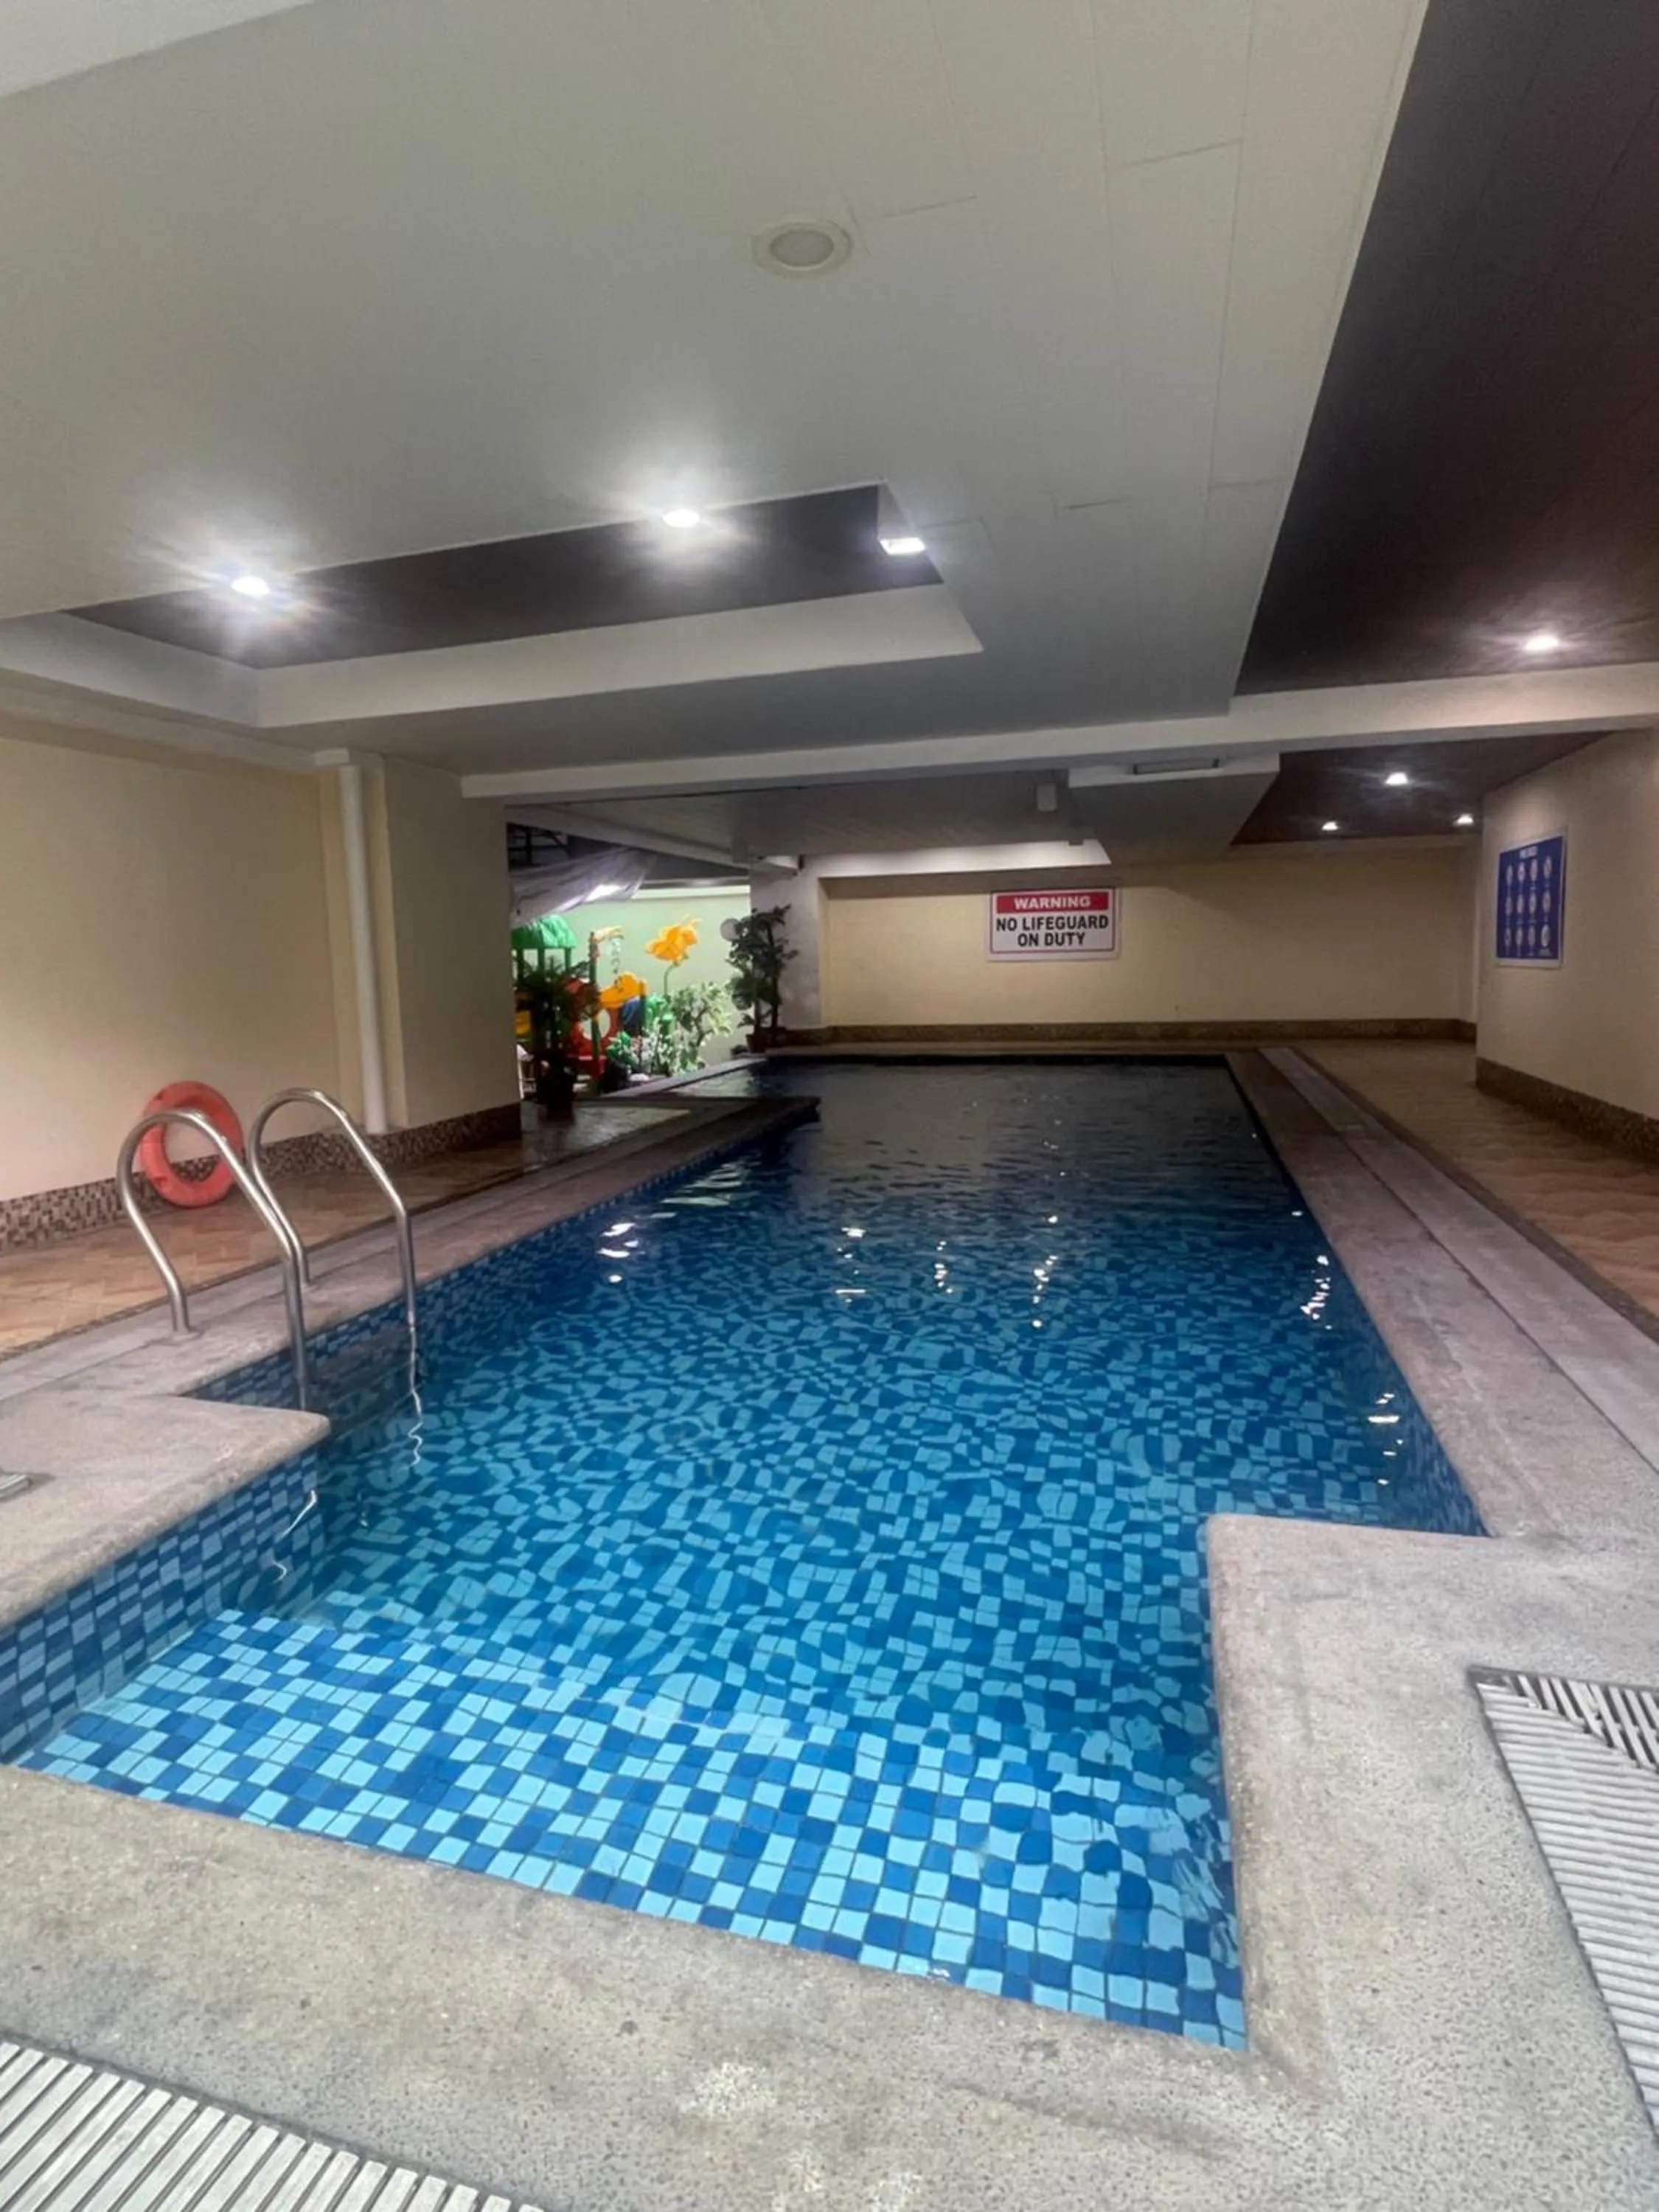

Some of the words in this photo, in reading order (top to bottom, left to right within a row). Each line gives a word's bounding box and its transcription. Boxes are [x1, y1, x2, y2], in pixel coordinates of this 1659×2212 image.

[1014, 896, 1091, 909] WARNING
[996, 917, 1017, 931] NO
[1022, 915, 1108, 931] LIFEGUARD
[1018, 934, 1039, 947] ON
[1044, 933, 1085, 946] DUTY
